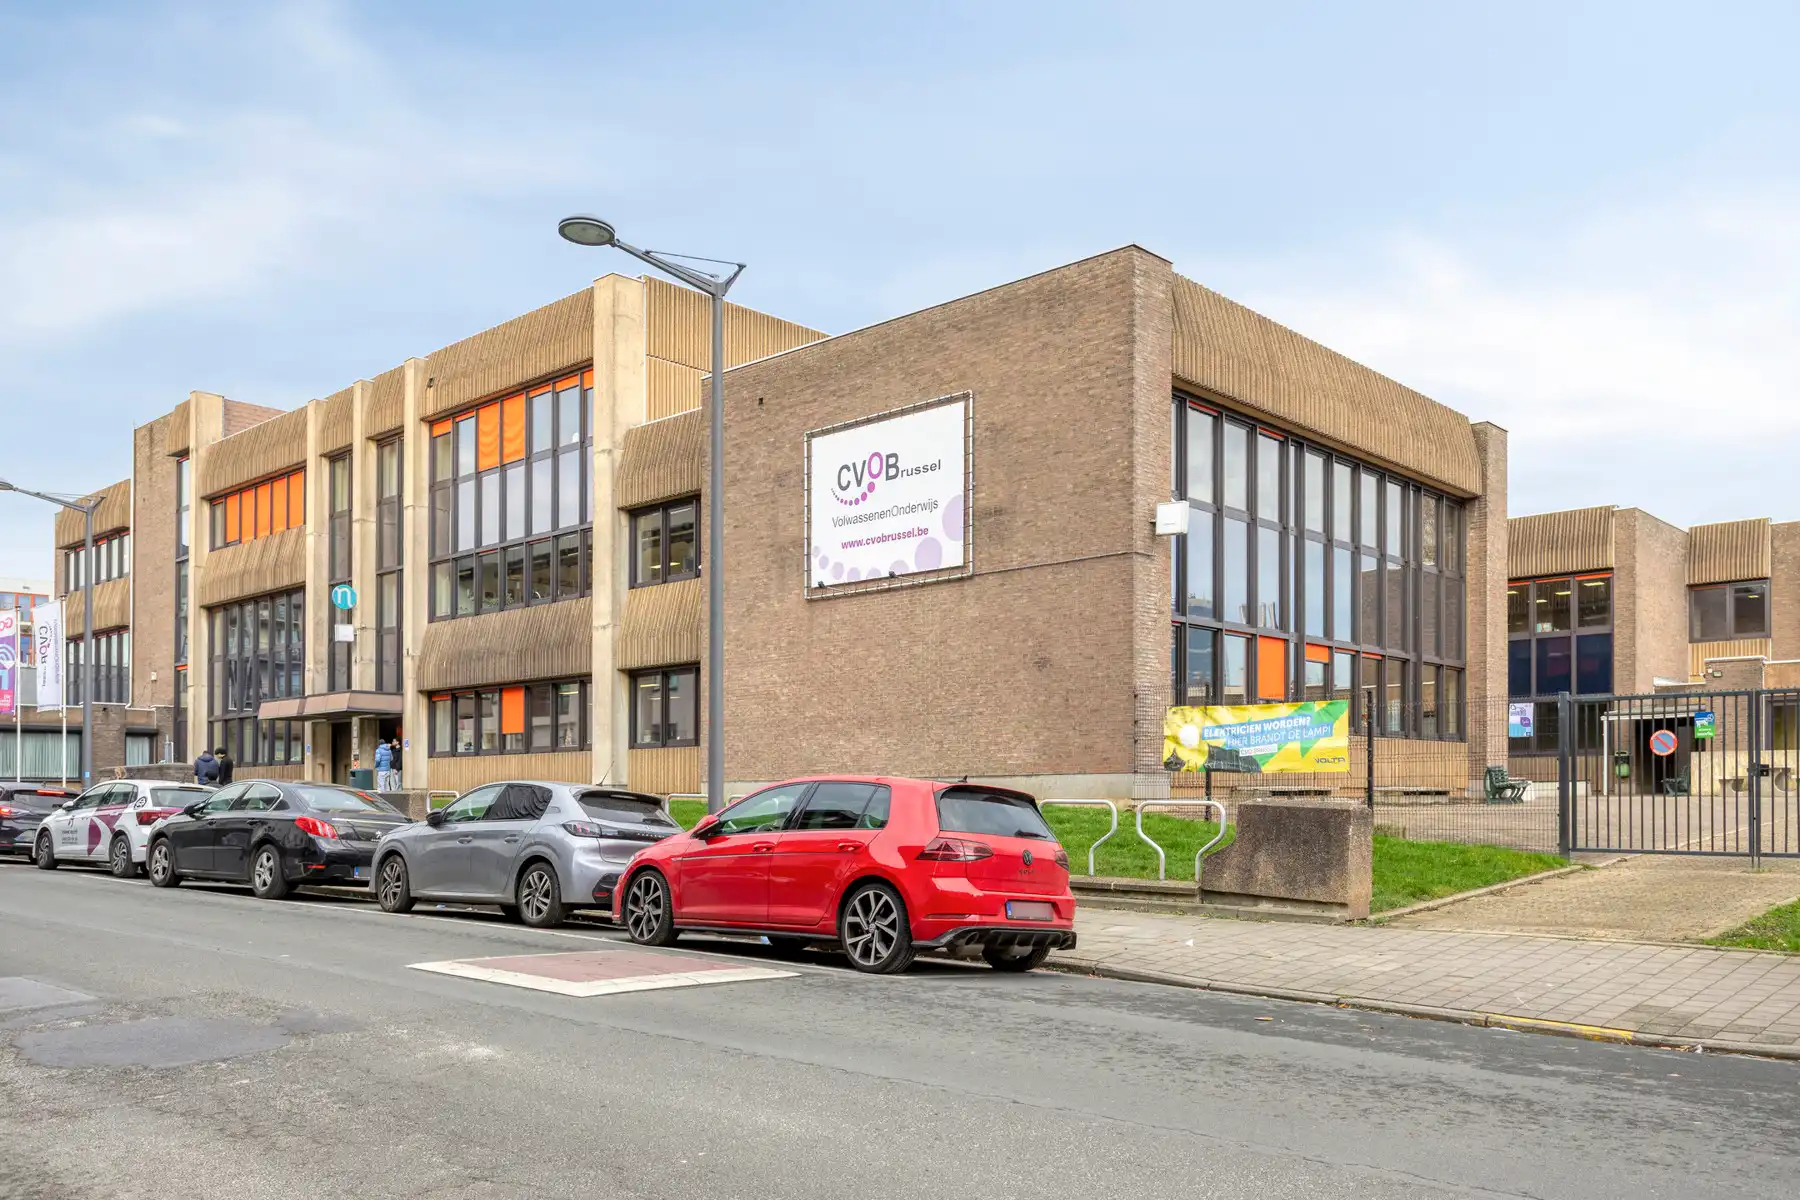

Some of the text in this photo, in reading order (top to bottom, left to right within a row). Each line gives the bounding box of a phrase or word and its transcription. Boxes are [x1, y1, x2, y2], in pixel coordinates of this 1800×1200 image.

[837, 452, 941, 491] CVOBrussel
[832, 499, 938, 528] VolwassenenOnderwijs
[841, 527, 929, 549] www.cvobrussel.be
[1263, 716, 1311, 731] WORDEN?
[1250, 731, 1286, 744] BRANDT
[1288, 729, 1300, 740] DE
